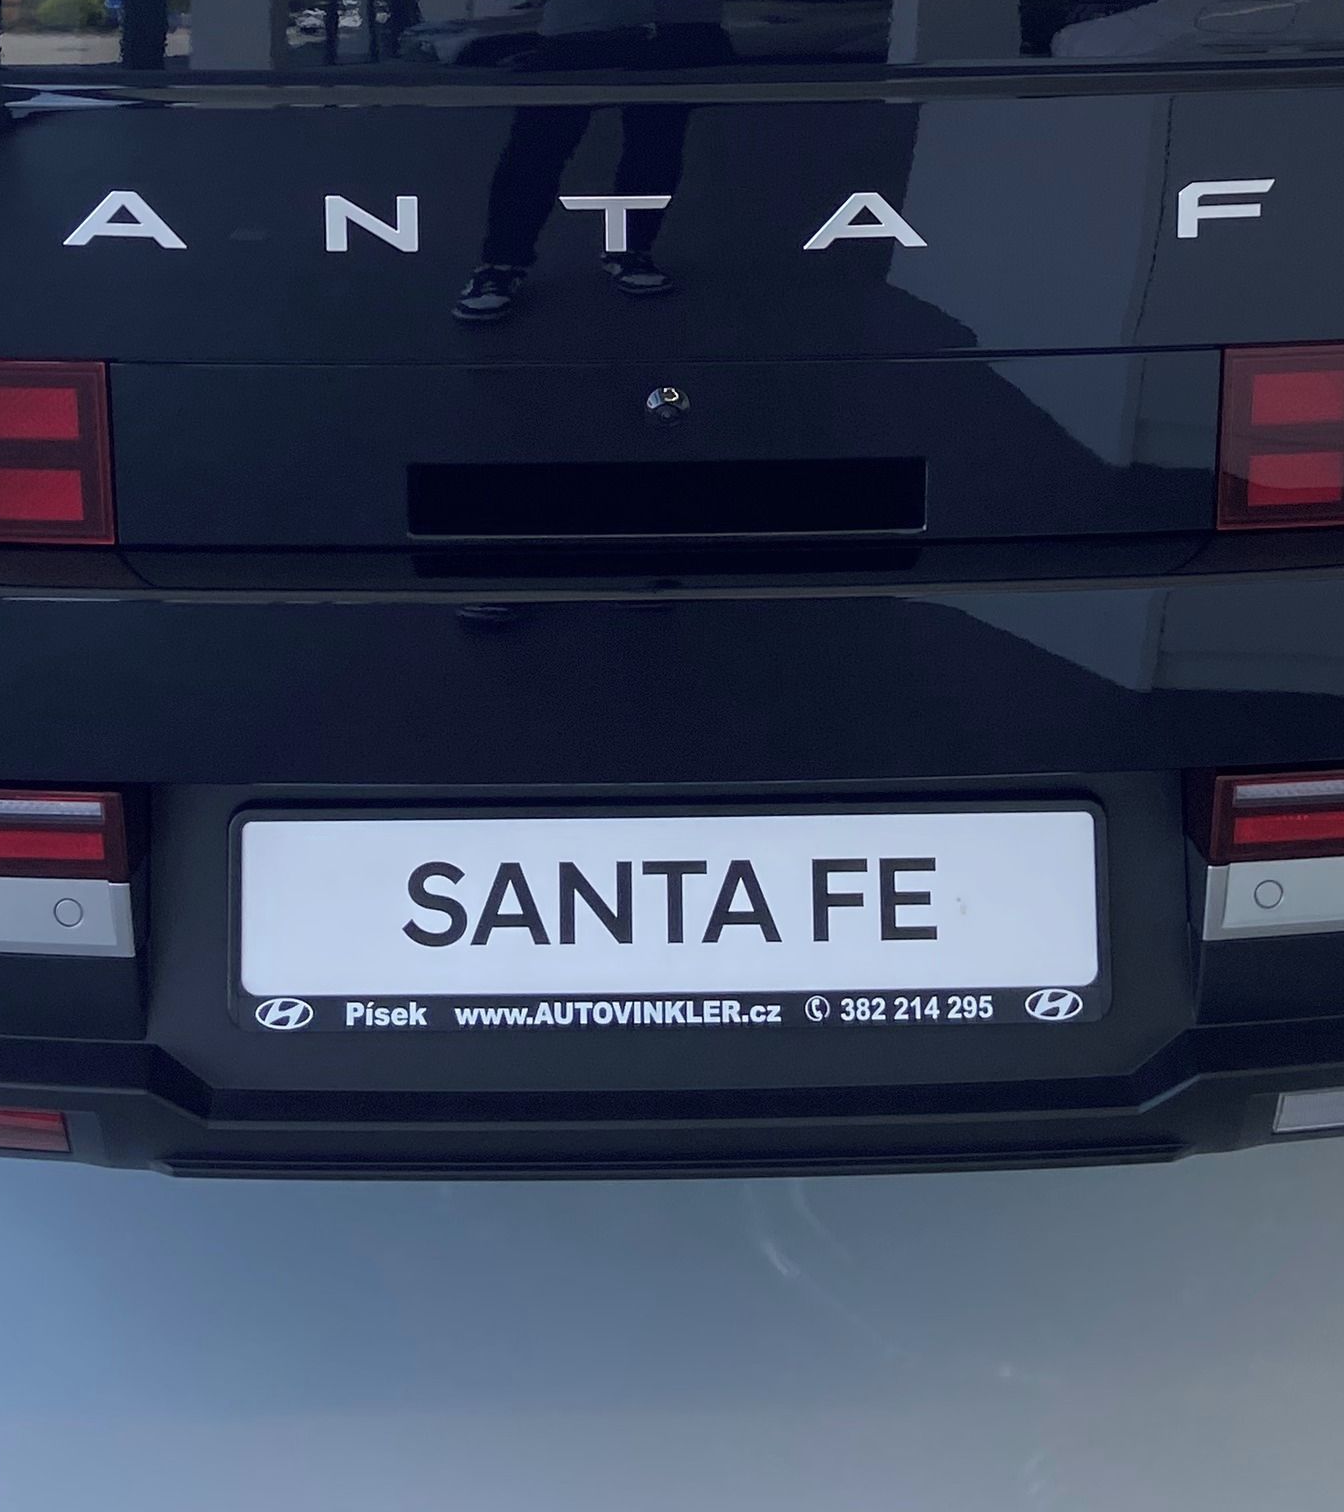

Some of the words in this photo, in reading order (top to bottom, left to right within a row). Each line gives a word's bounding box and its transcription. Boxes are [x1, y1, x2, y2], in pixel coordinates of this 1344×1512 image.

[402, 859, 782, 948] SANTA
[811, 857, 938, 943] FE
[346, 1002, 427, 1026] Písek
[455, 1000, 782, 1026] www.AUTOVINKLER.cz
[840, 998, 886, 1022] 382
[893, 997, 940, 1021] 214
[947, 996, 994, 1020] 295
